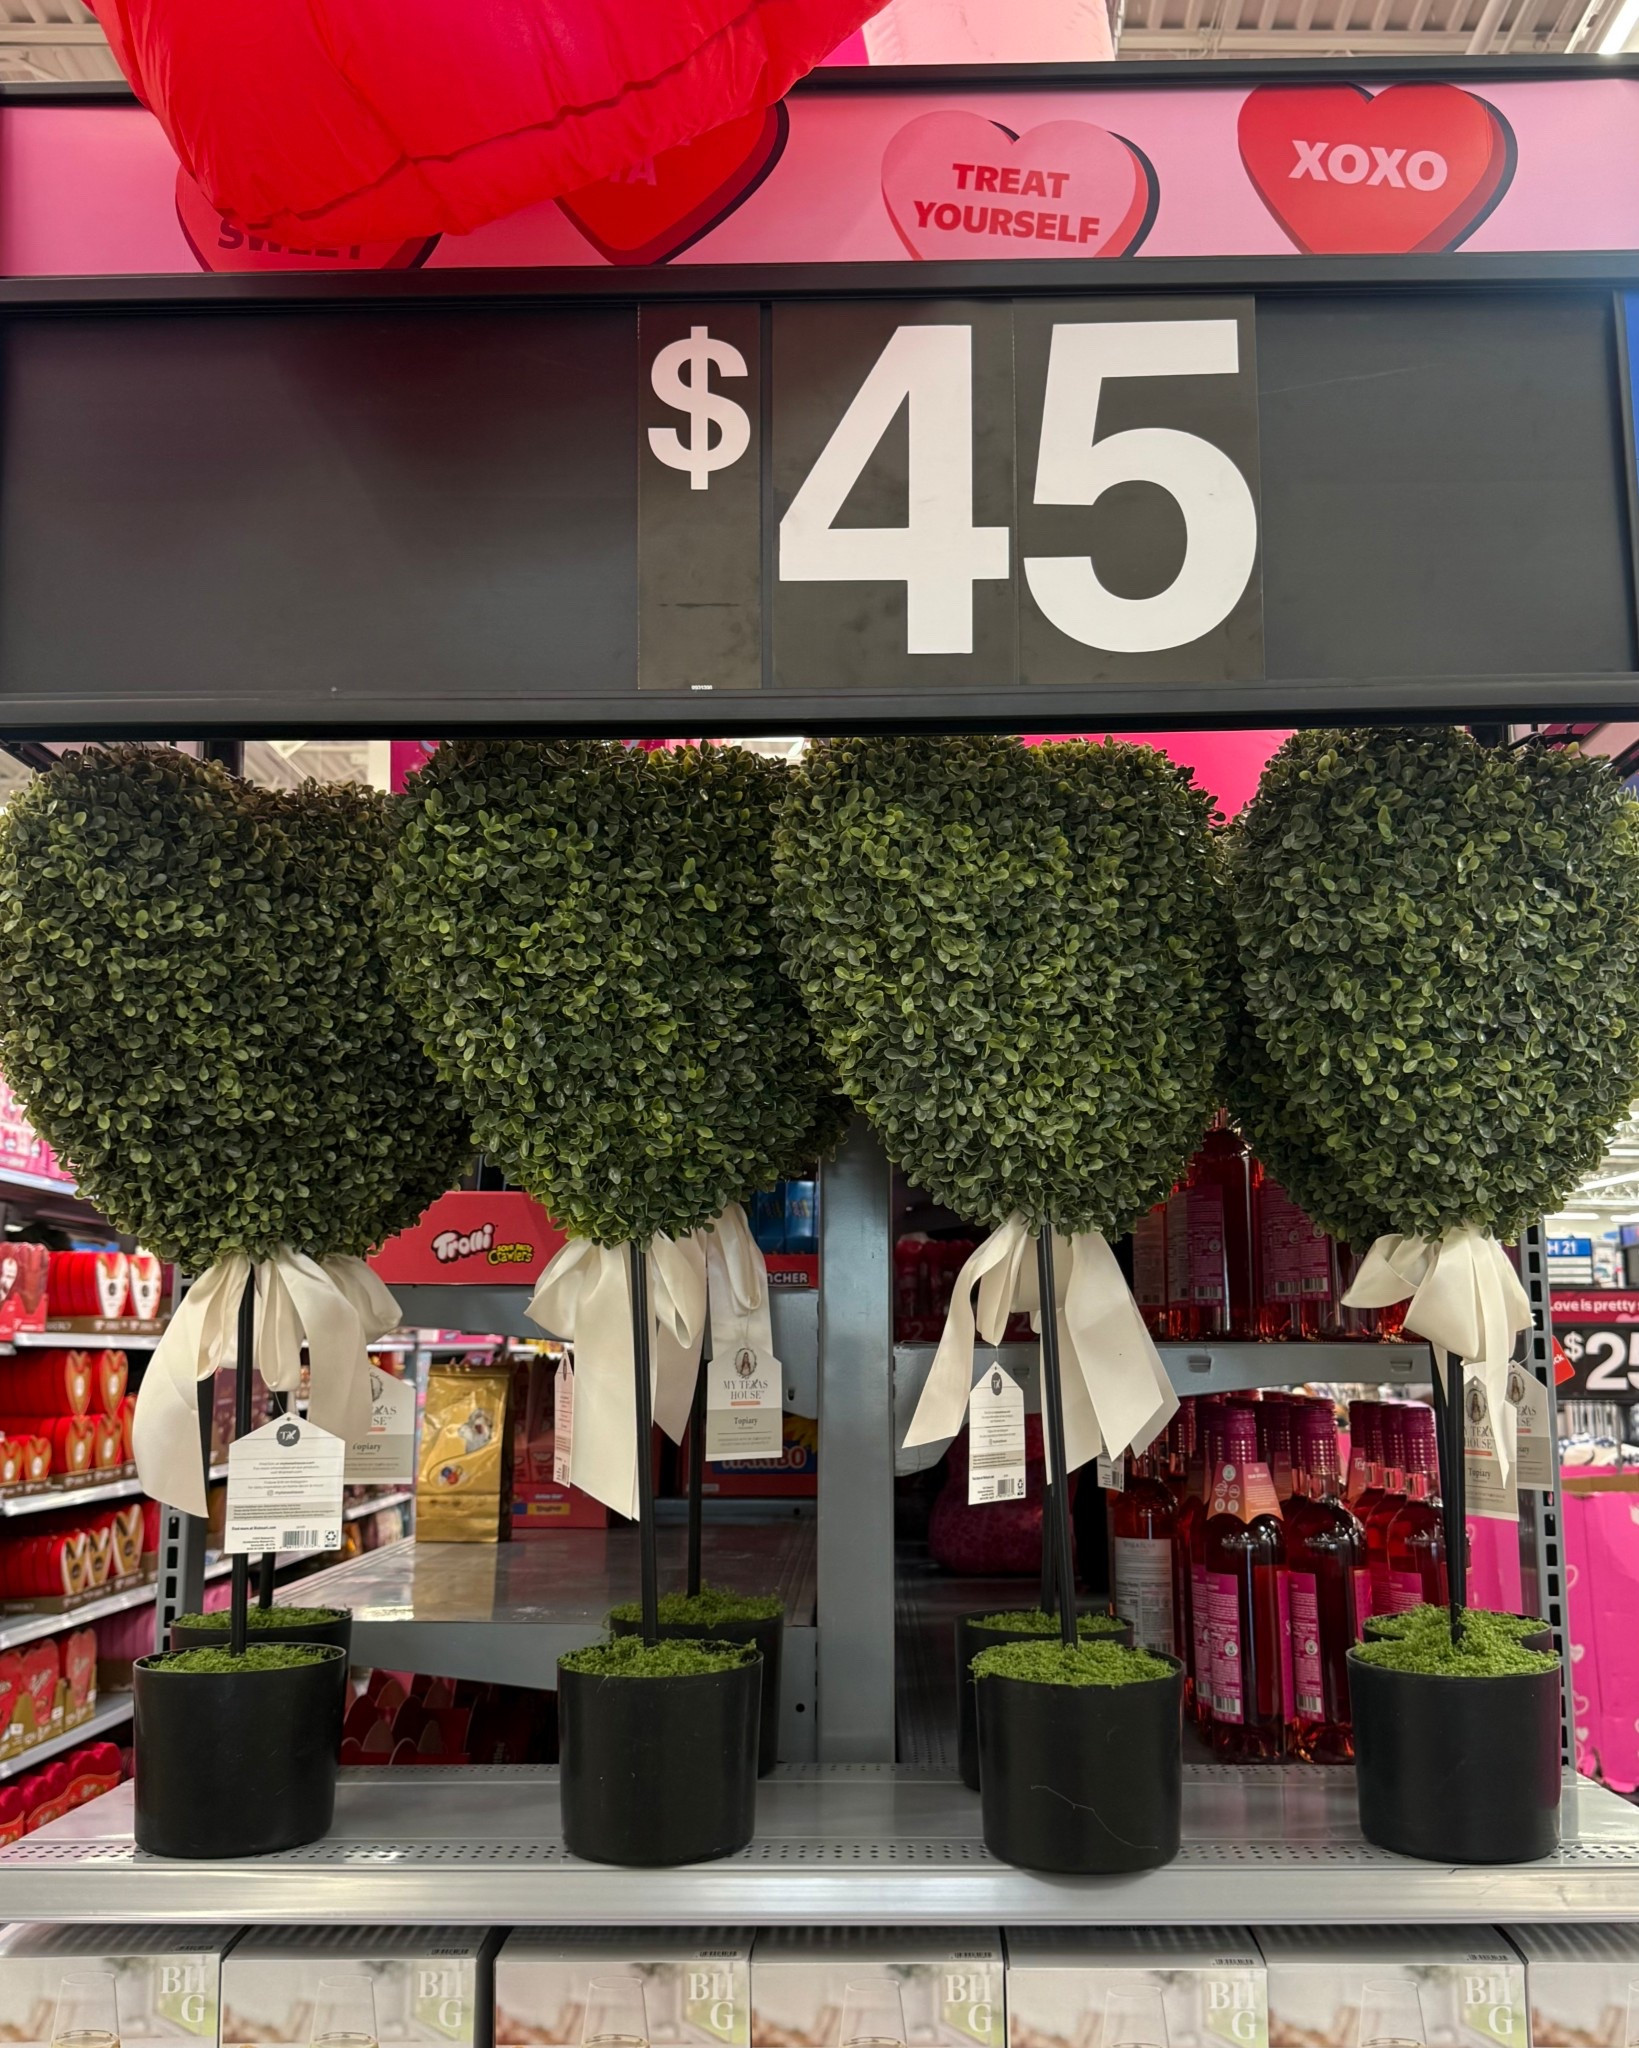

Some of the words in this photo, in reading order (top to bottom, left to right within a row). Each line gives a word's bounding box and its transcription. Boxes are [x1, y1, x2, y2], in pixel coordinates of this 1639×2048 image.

[1288, 140, 1448, 191] XOXO
[952, 163, 1070, 198] TREAT
[913, 200, 1100, 243] YOURSELF
[648, 319, 1257, 654] $45
[431, 1223, 494, 1262] Trolli
[487, 1248, 533, 1265] Crawlers
[1561, 1241, 1577, 1255] 21
[1581, 1298, 1592, 1311] is
[1594, 1299, 1637, 1314] pretty
[723, 1380, 736, 1390] MY
[739, 1379, 768, 1390] TEXAS
[372, 1404, 397, 1416] XAS
[734, 1416, 758, 1427] Topiary
[1517, 1405, 1537, 1416] EXAS
[1468, 1467, 1491, 1480] Topiary
[160, 1965, 208, 1994] BH
[418, 1970, 464, 1998] BH
[688, 1972, 735, 2000] BH
[944, 1974, 992, 2002] BH
[1464, 1976, 1513, 2004] BH
[181, 1994, 207, 2023] G
[1208, 1981, 1256, 2009] BH
[438, 1999, 463, 2028] G
[710, 2001, 735, 2030] G
[968, 2003, 993, 2032] G
[1231, 2010, 1256, 2039] G
[1488, 2005, 1514, 2035] G
